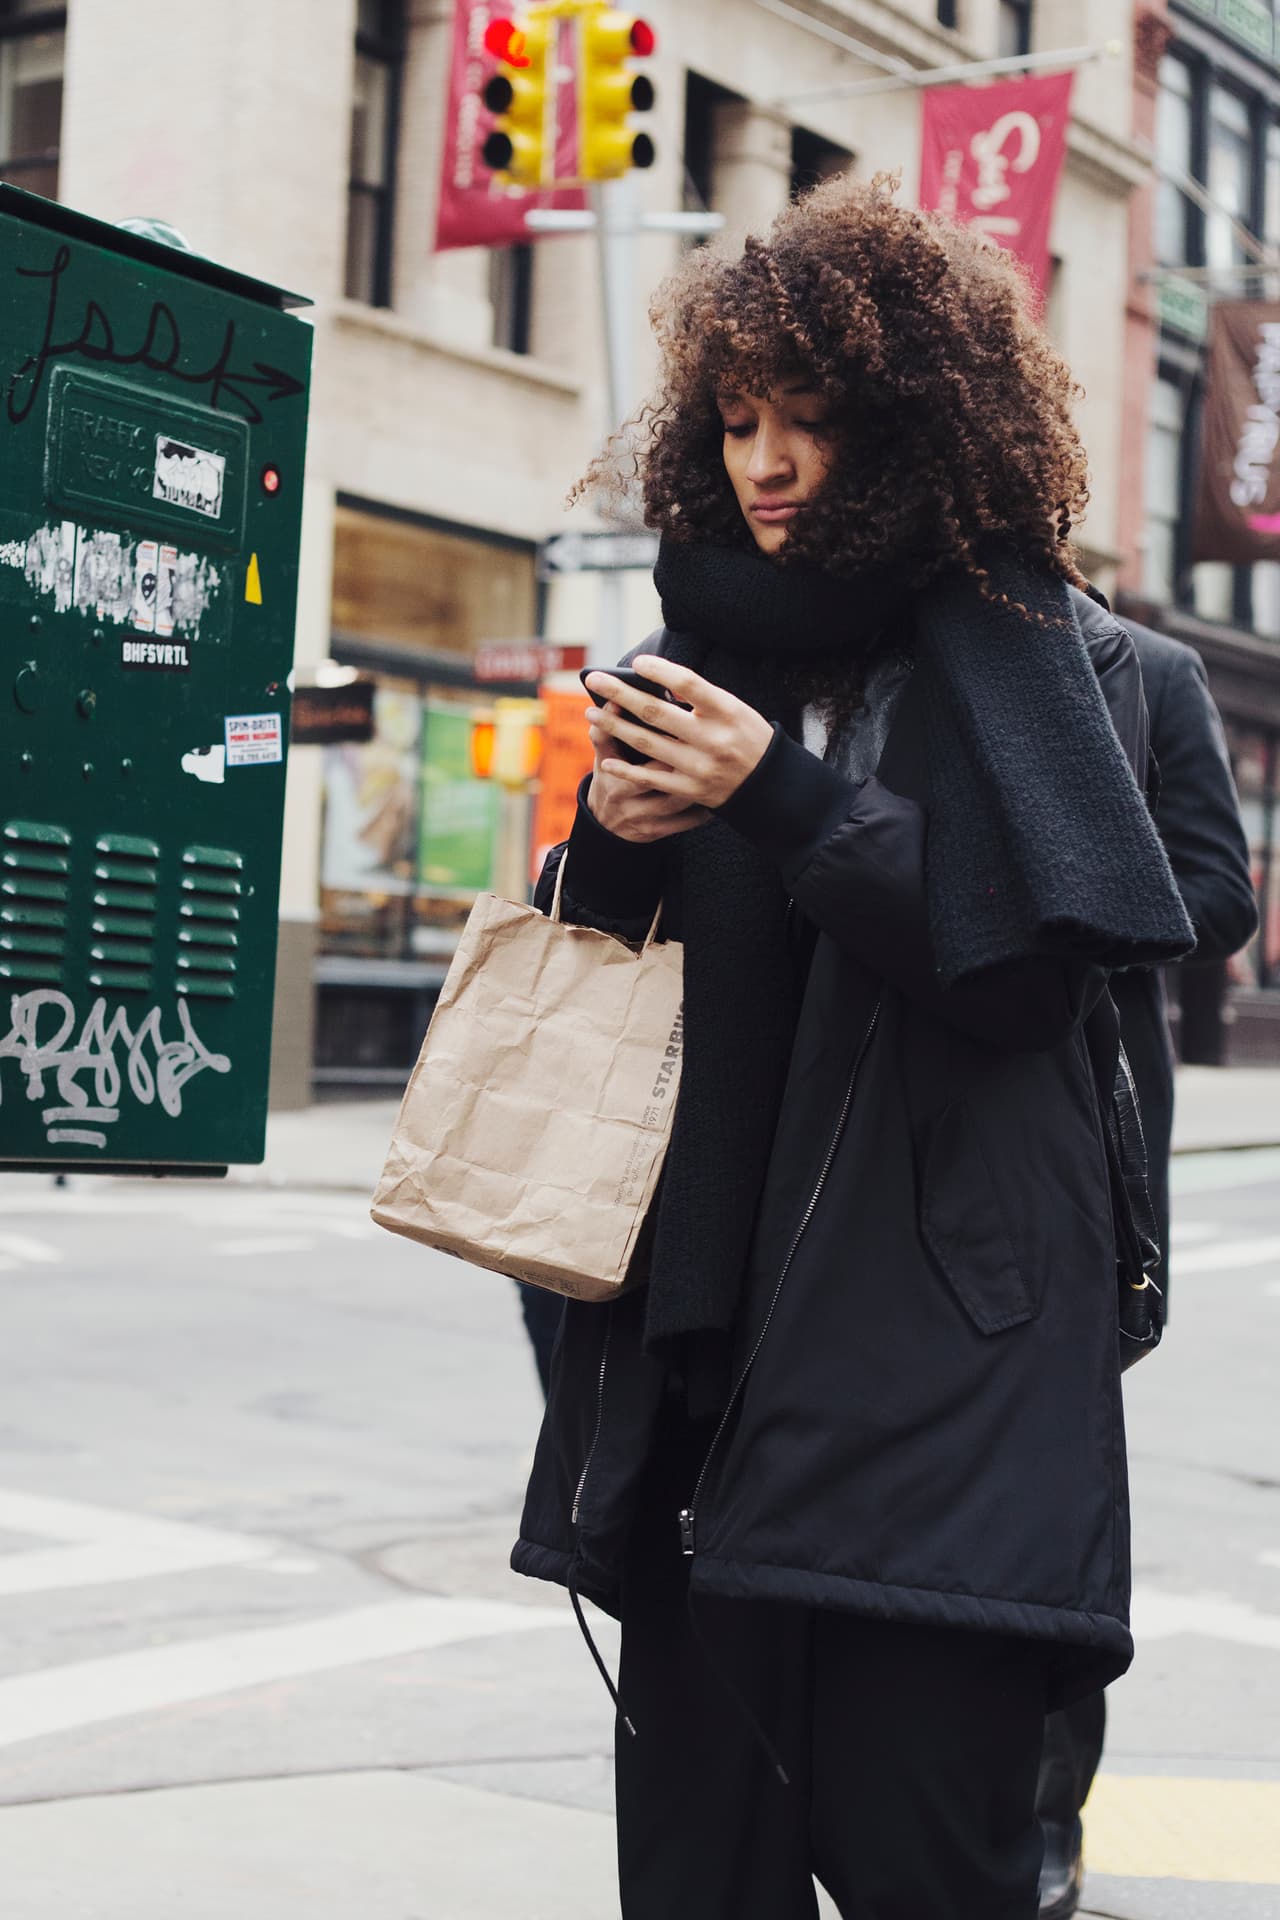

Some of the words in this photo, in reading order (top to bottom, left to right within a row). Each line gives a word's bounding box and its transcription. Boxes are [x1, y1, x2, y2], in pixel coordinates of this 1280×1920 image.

[123, 642, 189, 665] BHFSVRTL
[652, 1002, 684, 1099] STARB
[647, 1106, 660, 1126] 1971
